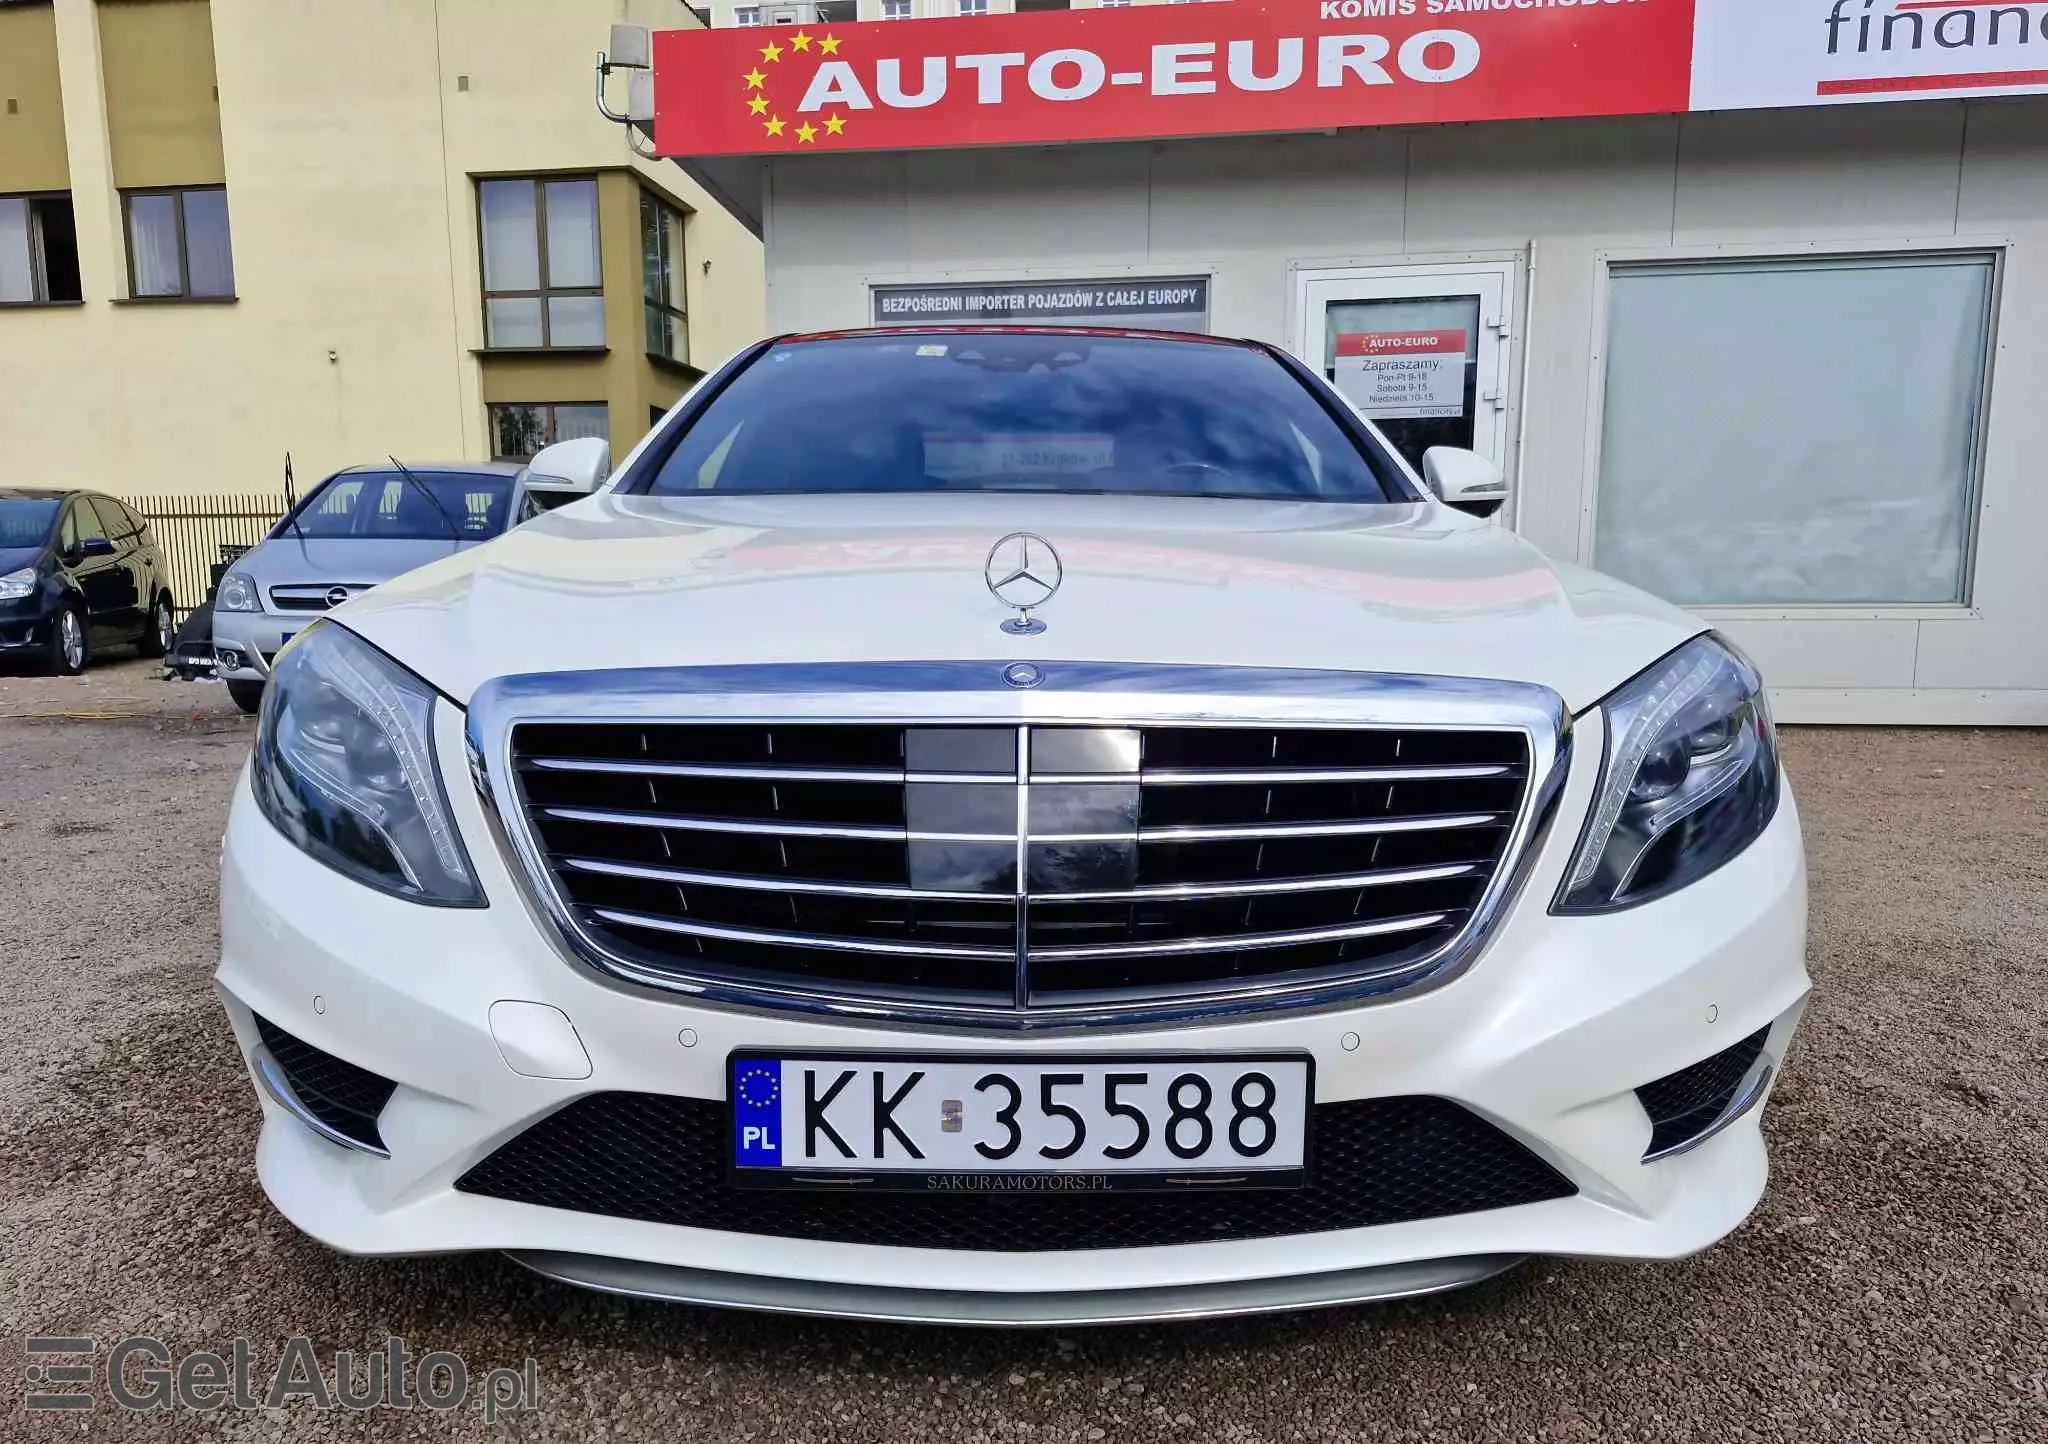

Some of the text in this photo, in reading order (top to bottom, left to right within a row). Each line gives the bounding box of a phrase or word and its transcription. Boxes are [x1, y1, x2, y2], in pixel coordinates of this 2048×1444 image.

[1320, 0, 1416, 20] KOMIS
[796, 29, 1481, 112] AUTO-EURO
[883, 288, 1197, 313] BEZPOŚREDNI IMPORTER POJAZDÓW Z CAŁEJ EUROPY
[1369, 336, 1438, 348] AUTO-EURO
[1410, 393, 1434, 402] 10-15
[803, 1069, 1277, 1160] KK 35588
[743, 1126, 776, 1150] PL
[927, 1174, 1112, 1191] SAKURAMOTORS.PL
